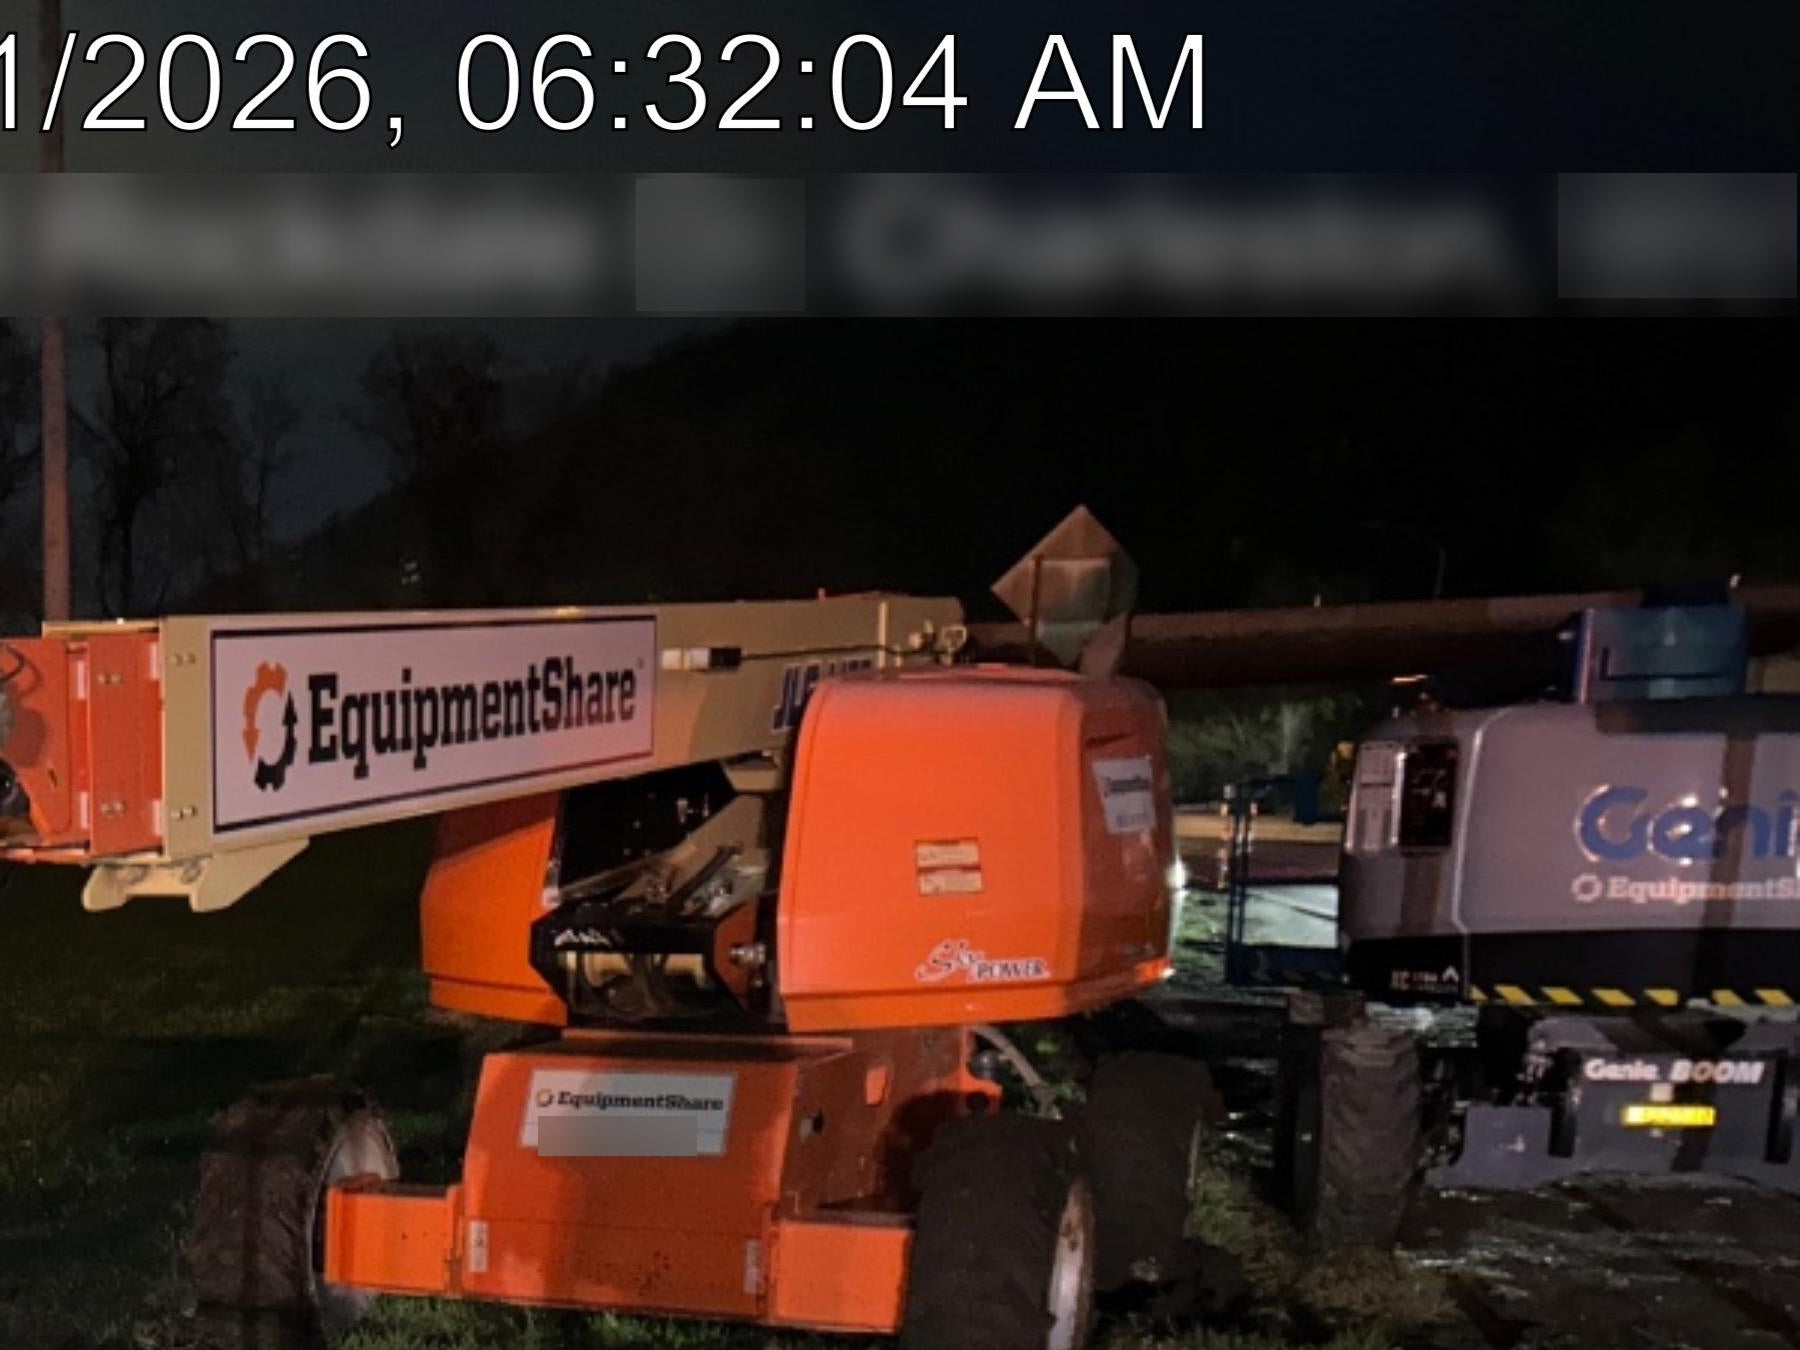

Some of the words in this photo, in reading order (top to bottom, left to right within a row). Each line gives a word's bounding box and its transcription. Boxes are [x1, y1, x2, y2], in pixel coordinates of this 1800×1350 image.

[307, 655, 638, 780] EquipmentShare
[1575, 783, 1800, 866] Geni
[1607, 875, 1800, 905] EquipmentS
[1584, 1058, 1659, 1082] Genie
[1669, 1059, 1765, 1084] BOOM
[557, 1091, 725, 1111] EquipmentShare
